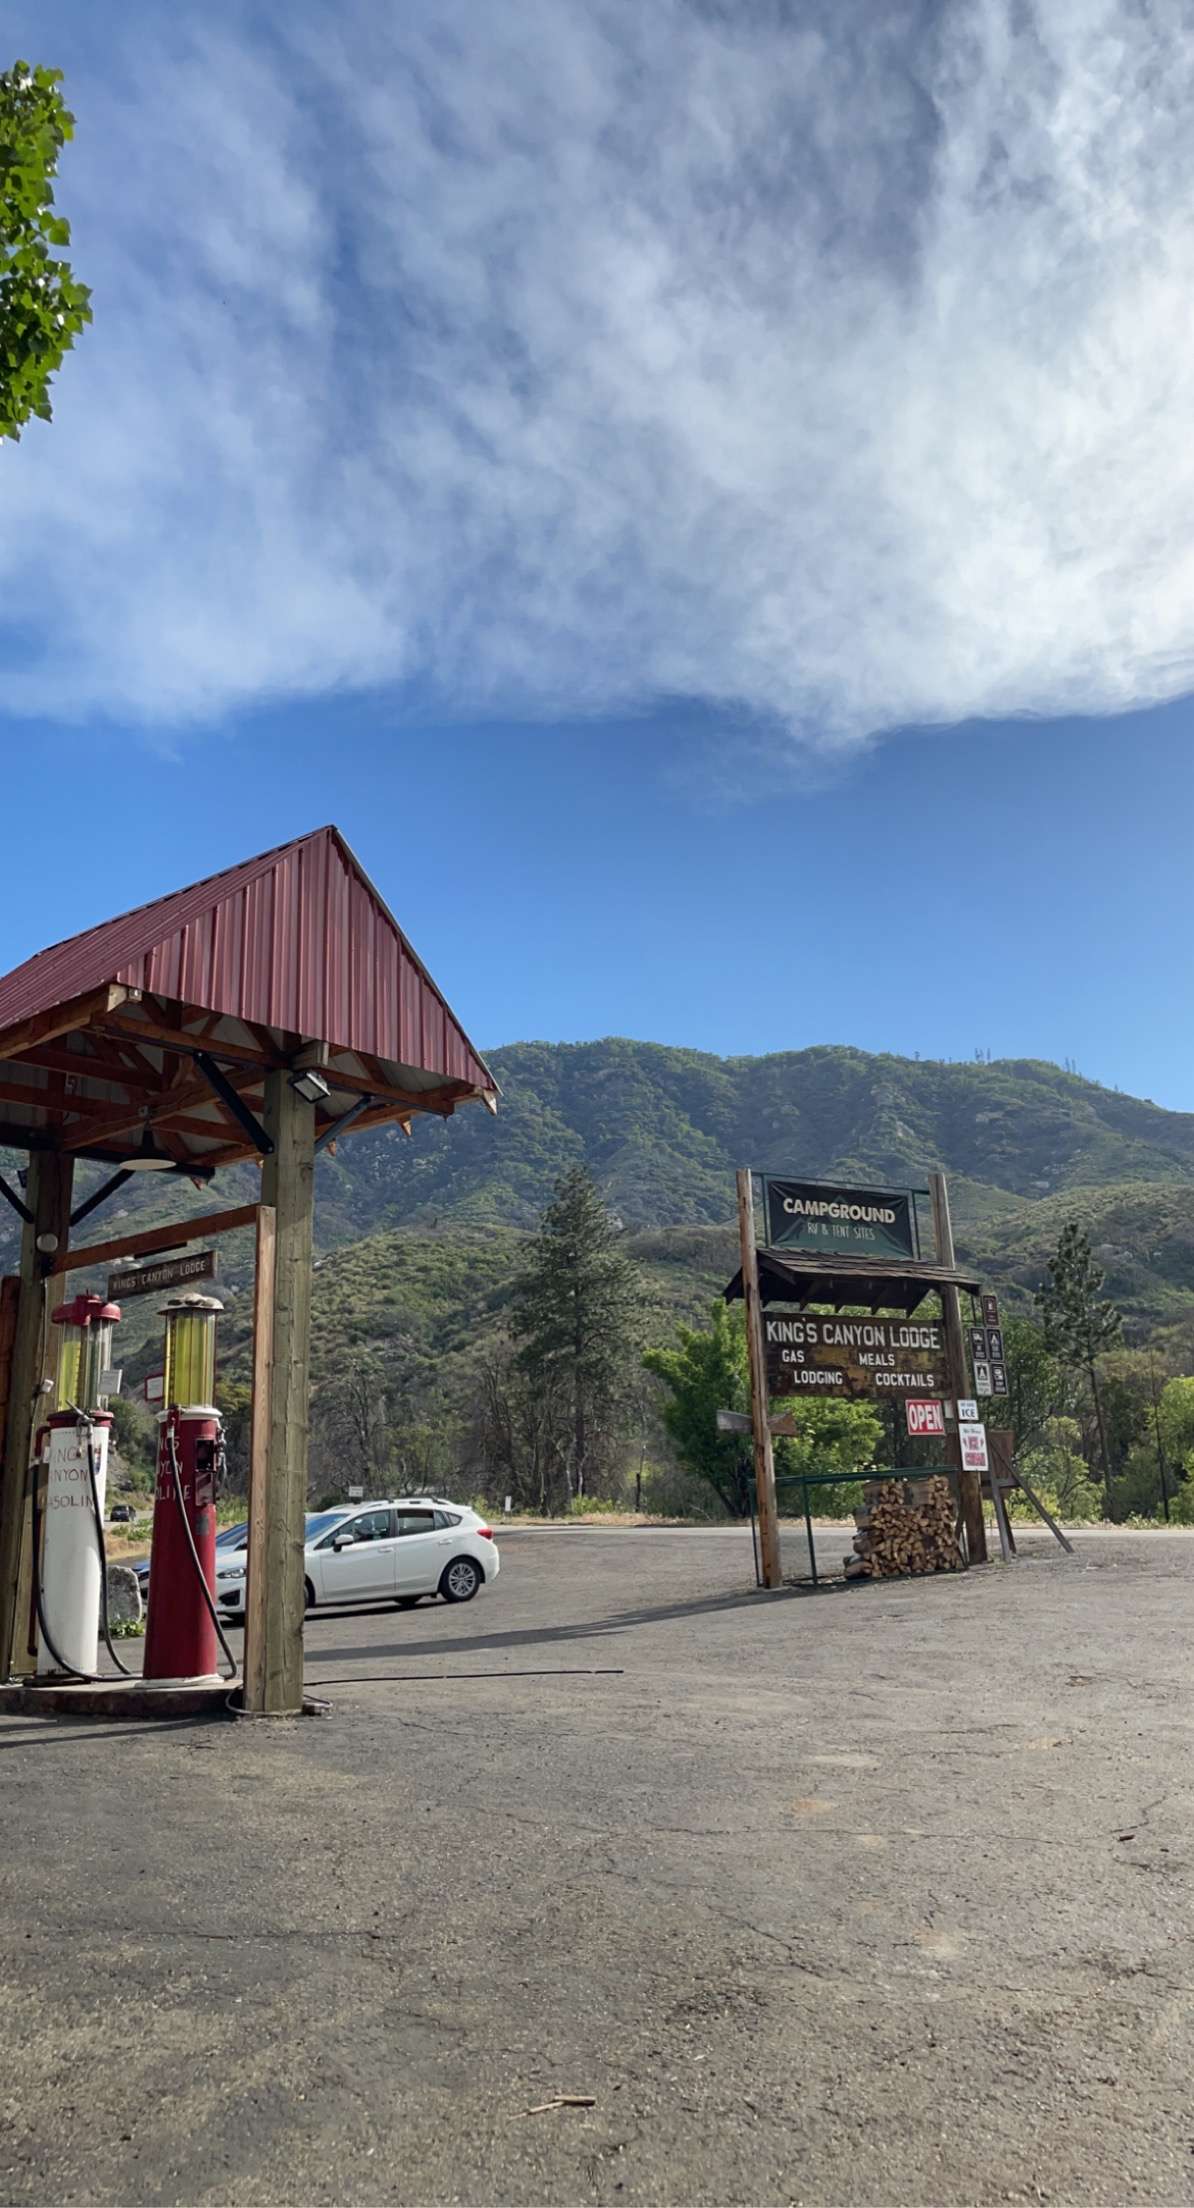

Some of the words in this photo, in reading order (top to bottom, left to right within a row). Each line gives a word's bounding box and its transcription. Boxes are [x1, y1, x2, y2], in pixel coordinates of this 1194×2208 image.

[783, 1198, 896, 1223] CAMPGROUND
[807, 1222, 818, 1235] RV
[822, 1223, 828, 1235] &
[832, 1224, 849, 1238] TENT
[853, 1226, 876, 1240] SITES
[142, 1268, 174, 1285] CANYON
[180, 1261, 206, 1276] LODGE
[766, 1317, 818, 1343] KING'S
[822, 1323, 886, 1347] CANYON
[889, 1326, 941, 1349] LODGE
[782, 1349, 805, 1363] GAS
[858, 1353, 895, 1367] MEALS
[793, 1370, 843, 1385] LODGING
[875, 1372, 935, 1387] COCKTAILS
[909, 1404, 943, 1431] OPEN
[961, 1408, 976, 1418] ICE
[51, 1468, 88, 1482] NYON
[49, 1495, 95, 1509] SOLIN
